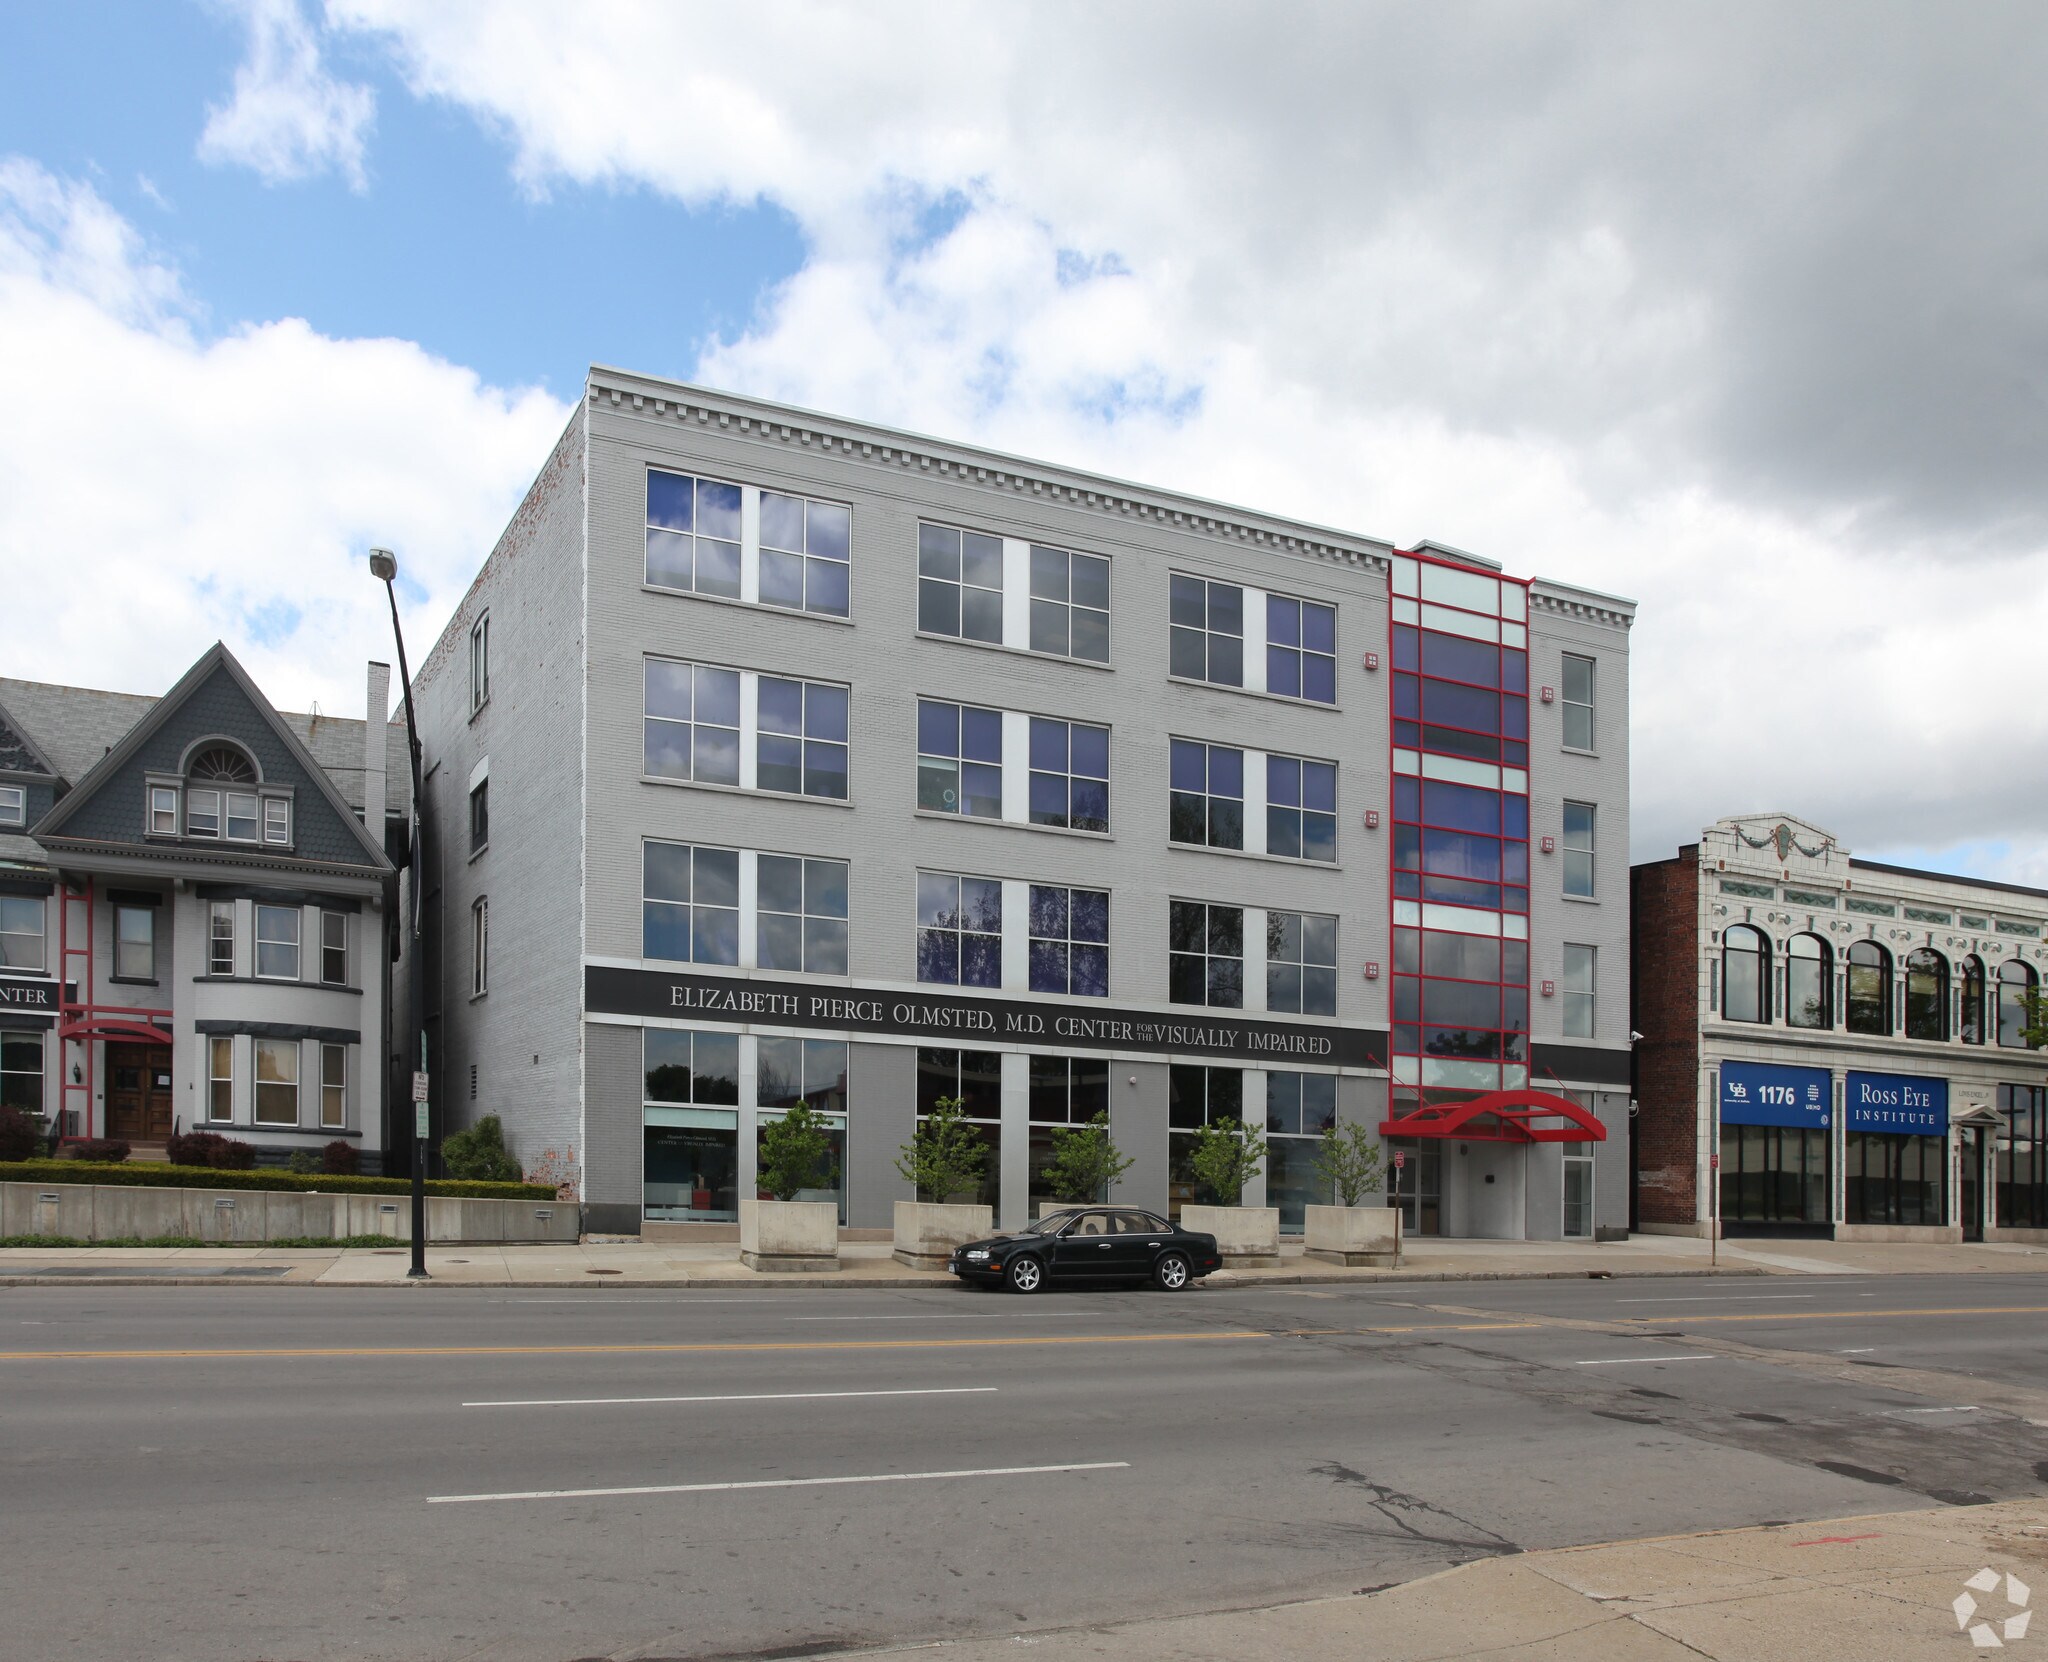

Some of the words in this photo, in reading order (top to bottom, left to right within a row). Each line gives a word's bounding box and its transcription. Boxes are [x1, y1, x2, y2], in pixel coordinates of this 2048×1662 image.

[670, 985, 799, 1016] ELIZABETH
[810, 997, 883, 1021] PIERCE
[893, 1003, 997, 1033] OLMSTED,
[1005, 1013, 1045, 1034] M.D.
[1055, 1016, 1134, 1041] CENTER
[1136, 1023, 1153, 1033] FOR
[1136, 1032, 1153, 1042] THE
[1152, 1023, 1239, 1048] VISUALLY
[1247, 1031, 1332, 1055] IMPAIRED
[1728, 1082, 1746, 1097] UB
[1759, 1085, 1795, 1105] 1176
[1860, 1083, 1898, 1105] ROSS
[1903, 1086, 1930, 1107] EYE
[1855, 1109, 1935, 1125] INSTITUTE
